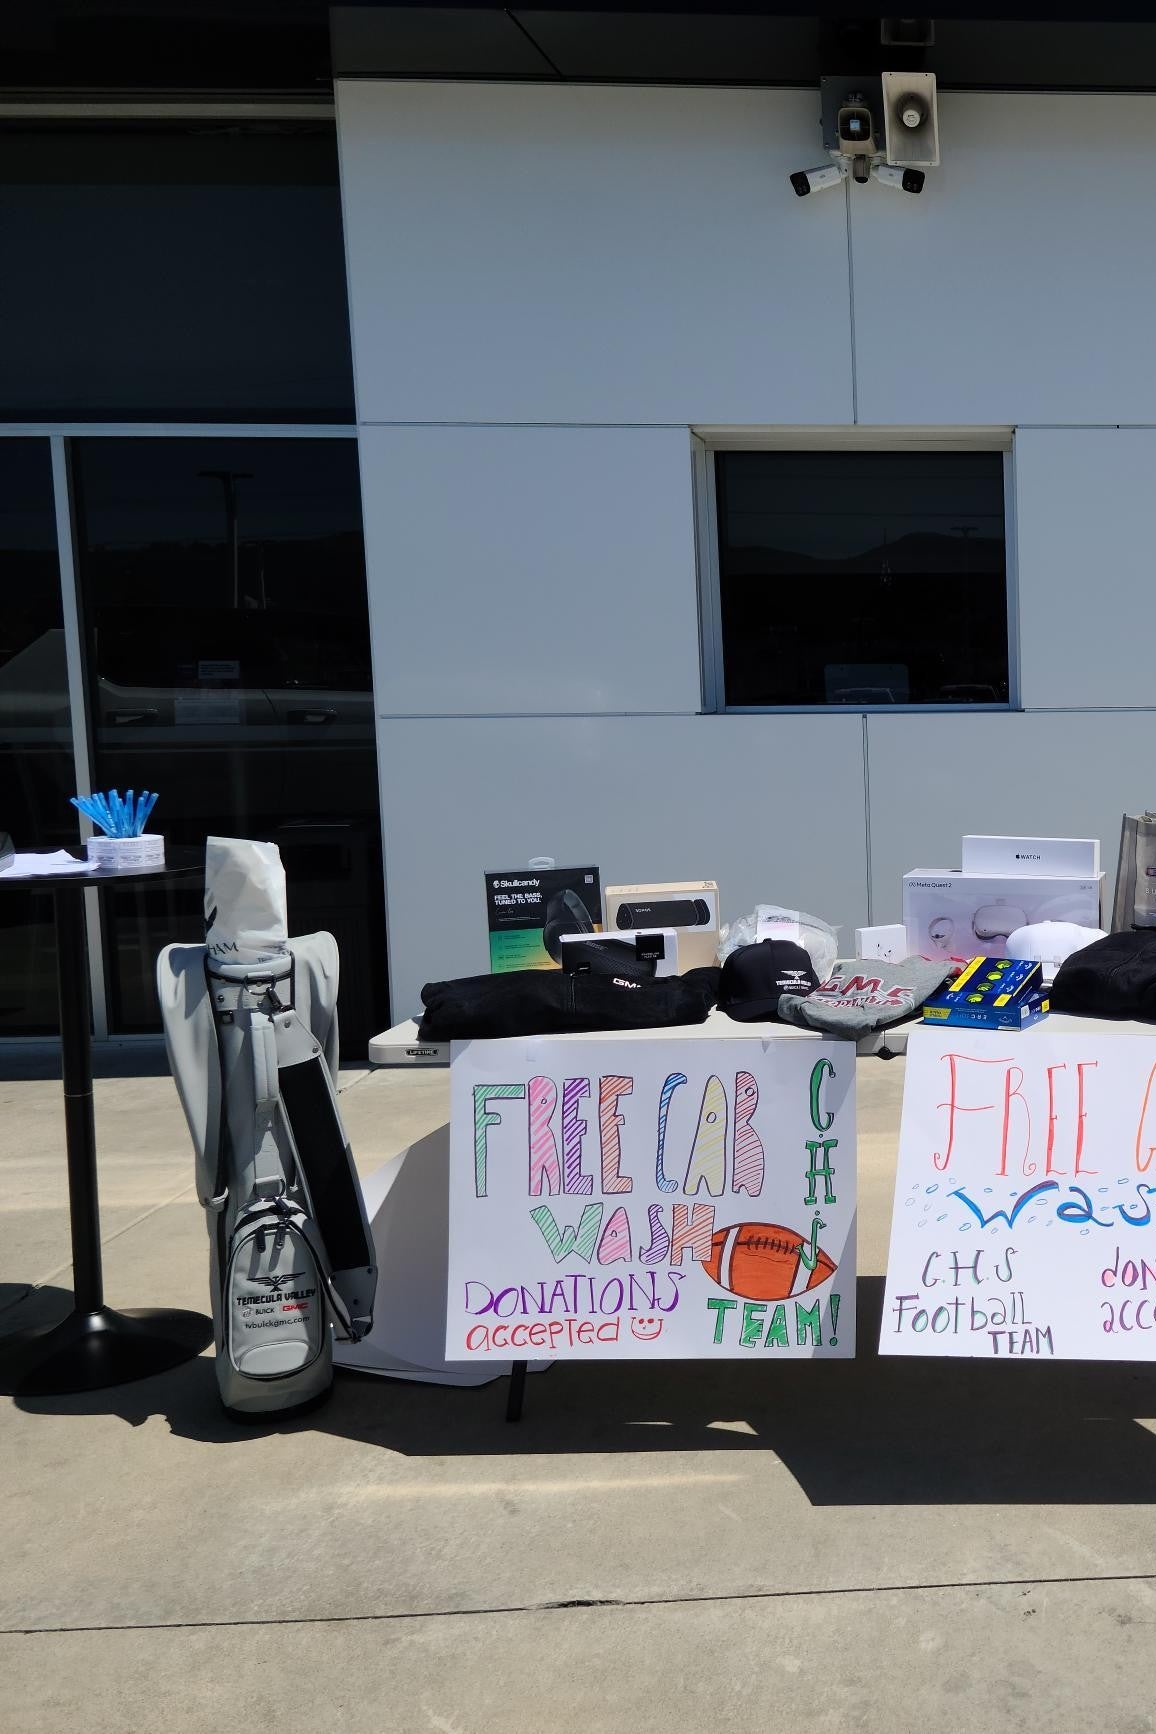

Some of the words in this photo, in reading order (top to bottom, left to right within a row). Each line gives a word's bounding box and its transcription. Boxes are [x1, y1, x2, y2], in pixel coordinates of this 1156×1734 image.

[500, 879, 540, 888] Skullcandy
[612, 977, 642, 989] GM
[933, 1053, 1099, 1177] FREE
[473, 1075, 634, 1198] FREE
[655, 1071, 765, 1198] CAR
[529, 1202, 716, 1267] WASH
[237, 1292, 283, 1306] TEMECULA
[284, 1288, 316, 1301] VALLEY
[255, 1308, 275, 1316] BUICK
[282, 1302, 309, 1312] GMC
[465, 1271, 687, 1318] DONATIONS
[245, 1315, 310, 1329] tvbuickgmc.com
[706, 1294, 842, 1348] TEAM!
[988, 1325, 1055, 1355] TEAM
